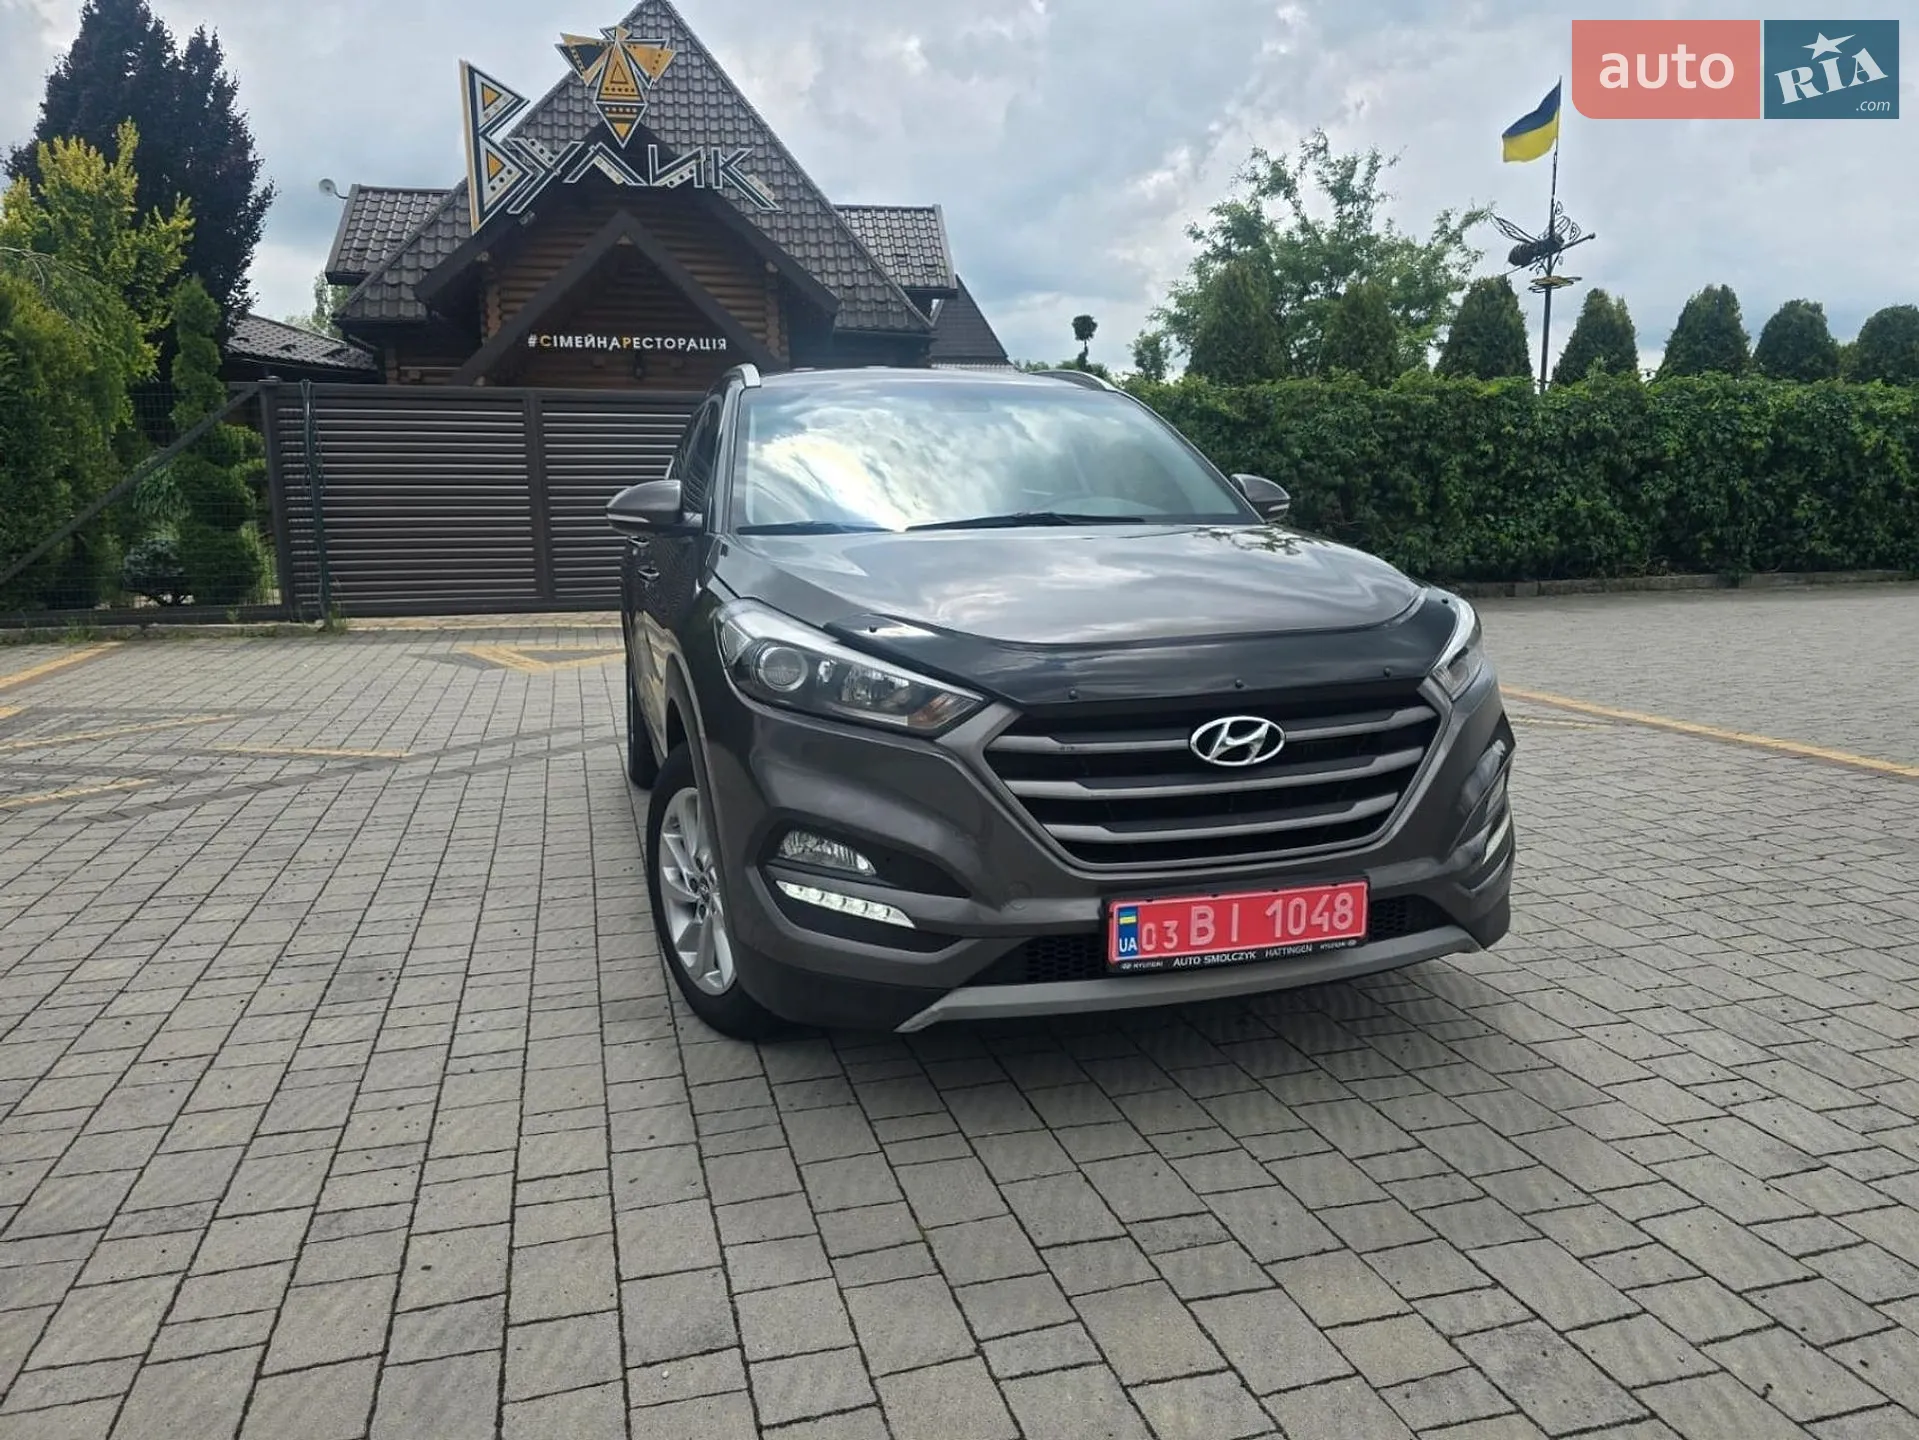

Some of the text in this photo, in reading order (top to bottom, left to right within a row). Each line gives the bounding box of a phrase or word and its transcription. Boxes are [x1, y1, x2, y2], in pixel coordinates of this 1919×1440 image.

[1141, 920, 1178, 951] 03
[1265, 892, 1353, 938] 1048
[1119, 937, 1138, 953] UA
[1173, 957, 1201, 967] AUTO
[1203, 950, 1257, 965] SMOLCZYK
